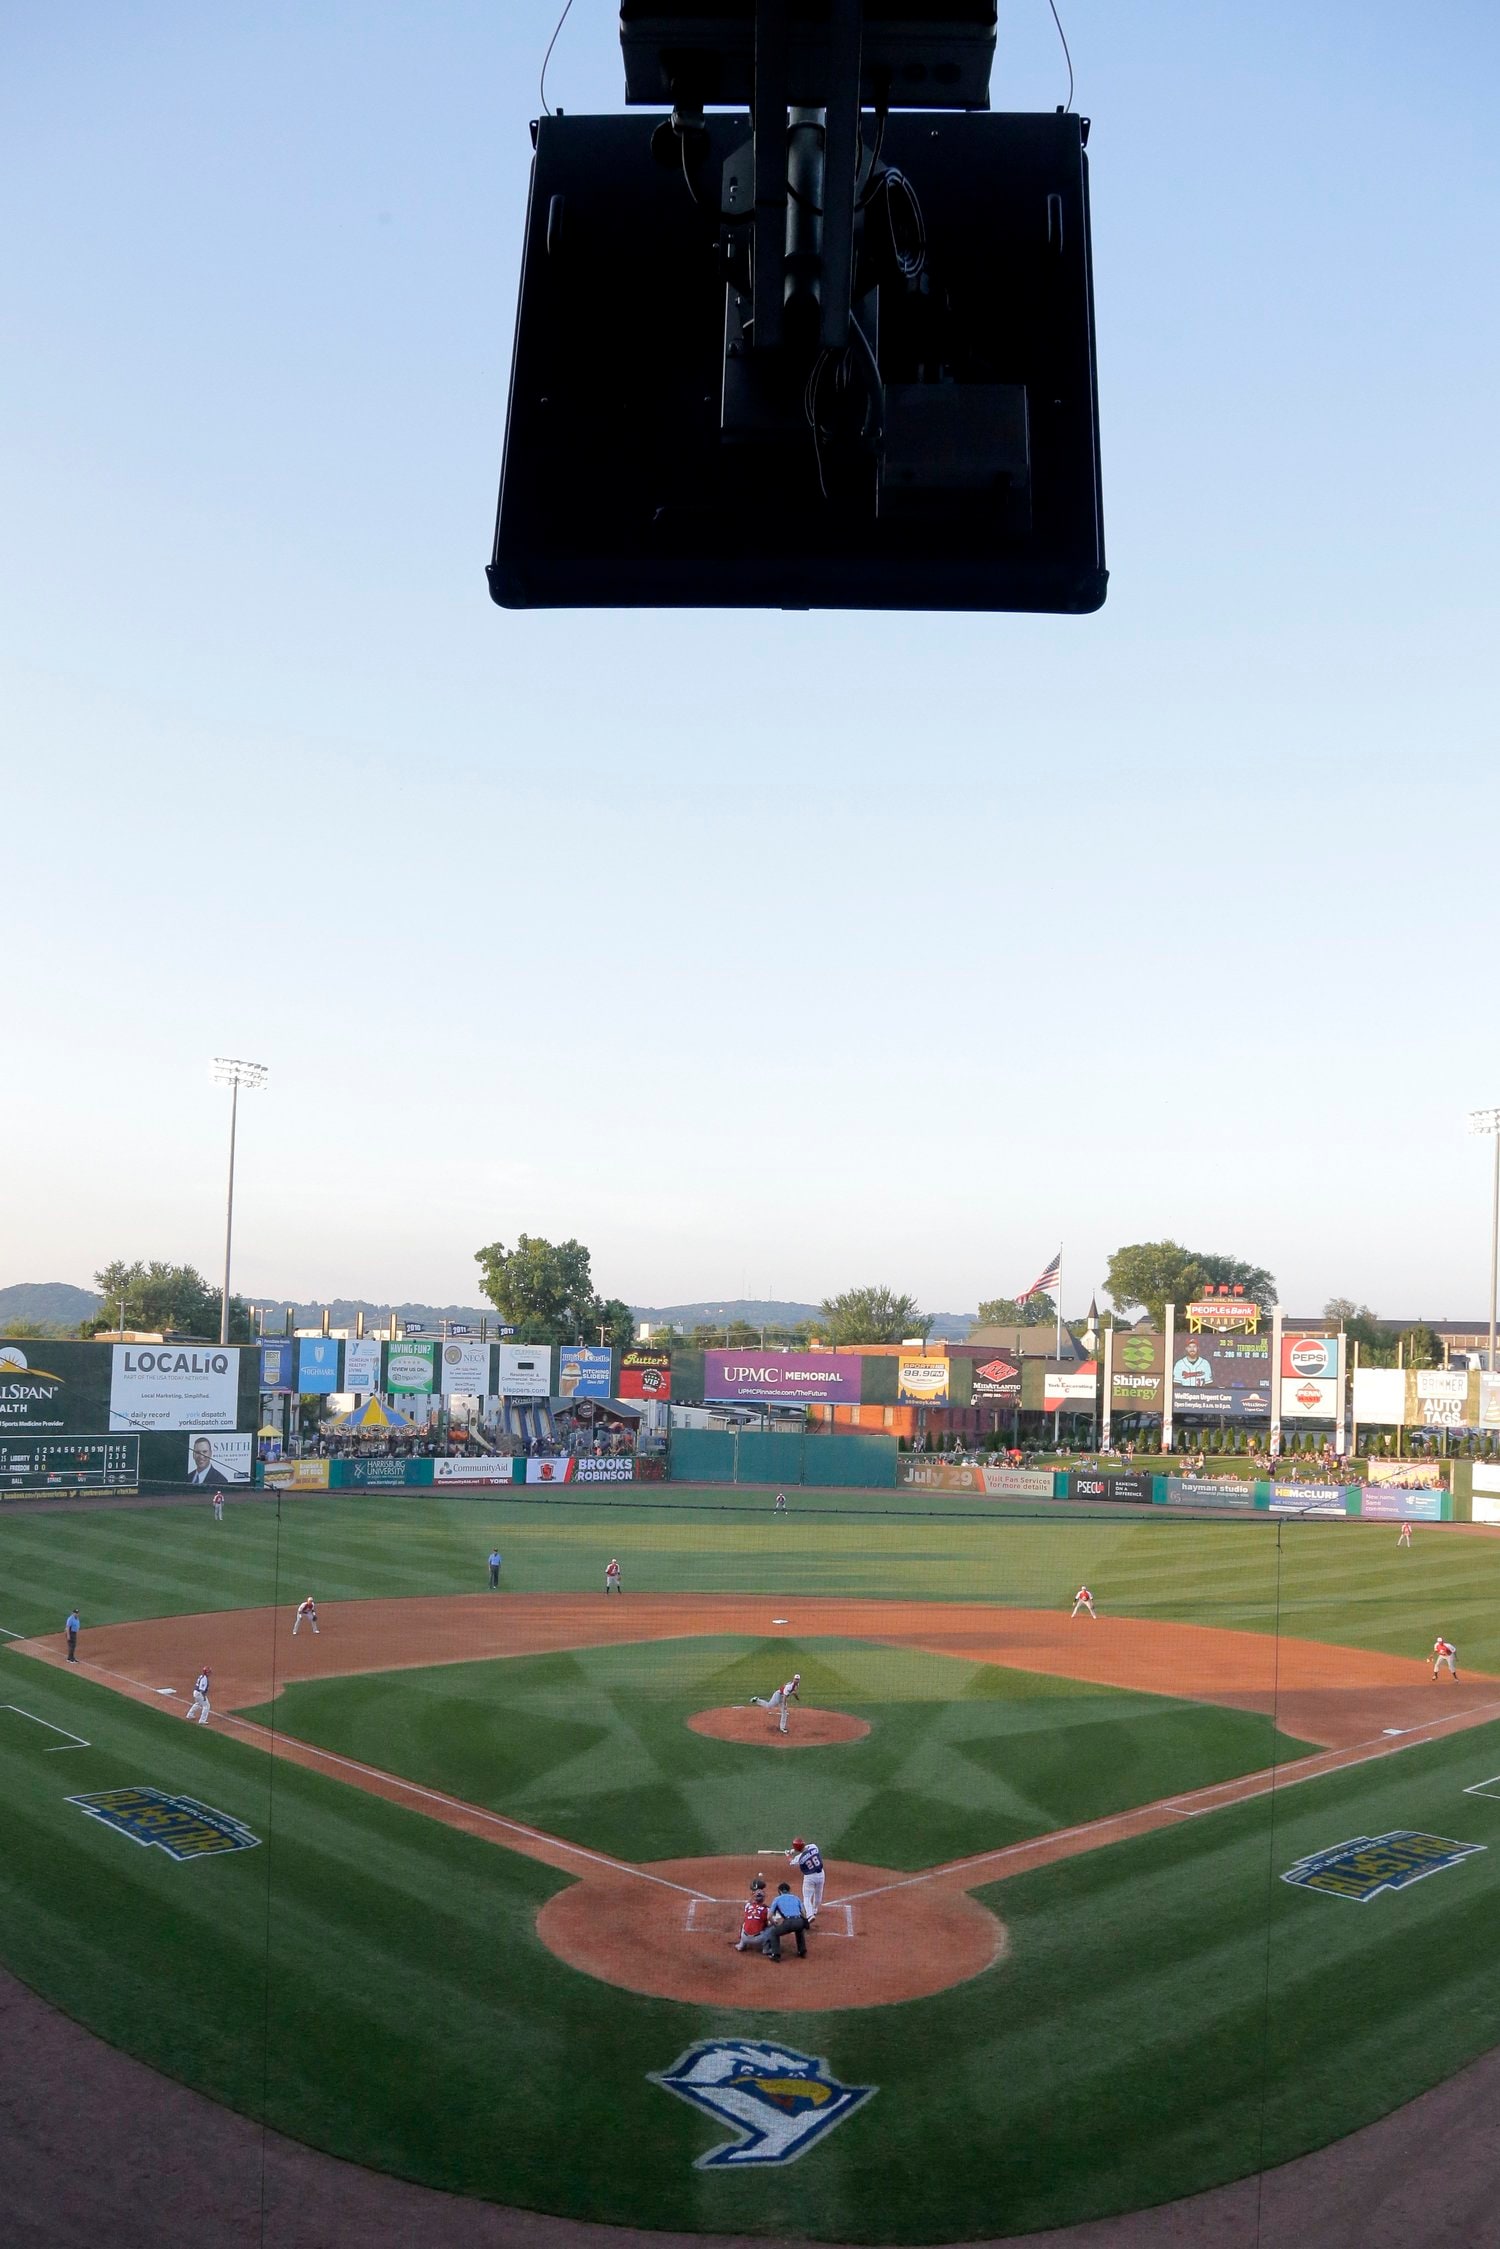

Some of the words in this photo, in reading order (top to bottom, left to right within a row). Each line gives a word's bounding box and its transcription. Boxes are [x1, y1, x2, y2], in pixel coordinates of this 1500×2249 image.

[453, 1326, 466, 1334] 2011
[390, 1344, 413, 1353] HAVING
[414, 1345, 431, 1354] FUN?
[464, 1354, 485, 1362] NECA
[624, 1352, 668, 1365] Rutter's
[1293, 1354, 1326, 1362] PEPSI
[304, 1368, 336, 1376] HIGHMARK
[724, 1367, 778, 1383] UPMC
[785, 1371, 843, 1382] MEMORIAL
[644, 1378, 659, 1386] VIP
[1113, 1374, 1160, 1389] Shipley
[1422, 1378, 1464, 1392] BRIMMER
[503, 1386, 545, 1394] kleppers.com
[738, 1388, 828, 1397] UPMCPinnacle.com/TheFuture
[1113, 1387, 1158, 1400] Energy
[1174, 1393, 1199, 1401] WellSpan
[1424, 1399, 1462, 1412] AUTO
[201, 1411, 226, 1419] dispatch
[1424, 1412, 1460, 1424] TAGS
[178, 1419, 233, 1427] yorkdispatch.com
[213, 1442, 250, 1452] SMITH
[367, 1460, 405, 1468] HARRISBURG
[453, 1463, 508, 1473] CommunityAid
[578, 1459, 632, 1470] BROOKS
[577, 1471, 632, 1480] ROBINSON
[904, 1468, 944, 1486] July
[948, 1471, 973, 1486] 29
[1020, 1477, 1050, 1485] Services
[1023, 1483, 1047, 1491] details
[1077, 1480, 1102, 1494] PSECU
[1182, 1483, 1217, 1493] hayman
[1220, 1485, 1248, 1493] studio
[159, 1796, 201, 1818] ATLANTIC
[198, 1814, 233, 1833] LEAGUE
[1311, 1852, 1354, 1872] ATLANTIC
[1350, 1838, 1389, 1856] LEAGUE
